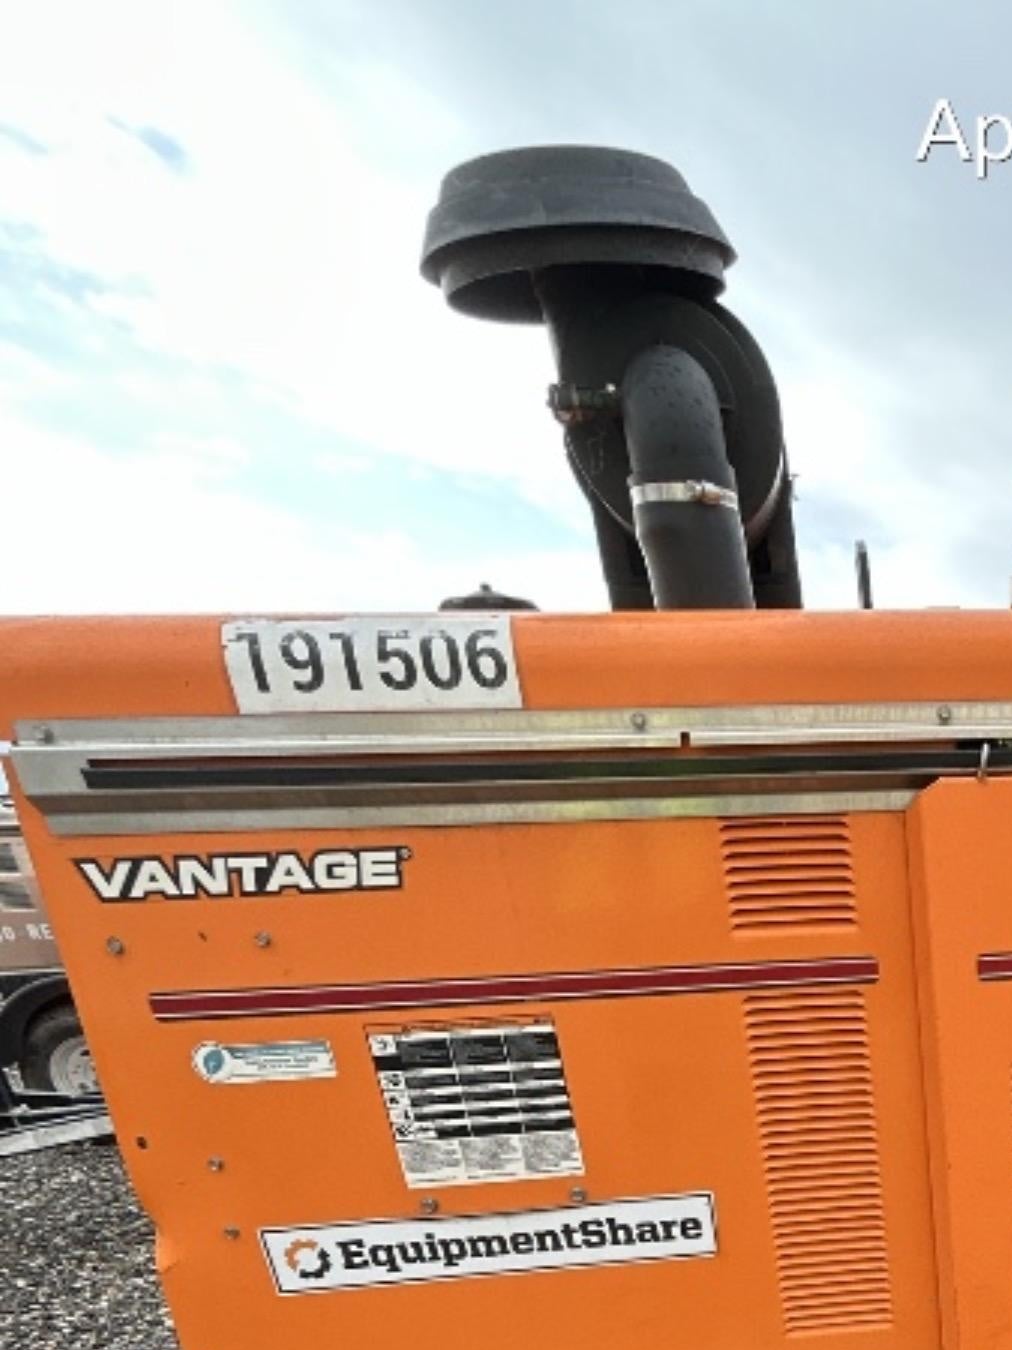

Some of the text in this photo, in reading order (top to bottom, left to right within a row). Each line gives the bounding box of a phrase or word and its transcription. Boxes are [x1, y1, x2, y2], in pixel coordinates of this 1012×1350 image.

[228, 628, 508, 693] 191506
[75, 848, 402, 900] VANTAGE
[336, 1213, 702, 1272] EquipmentShare
